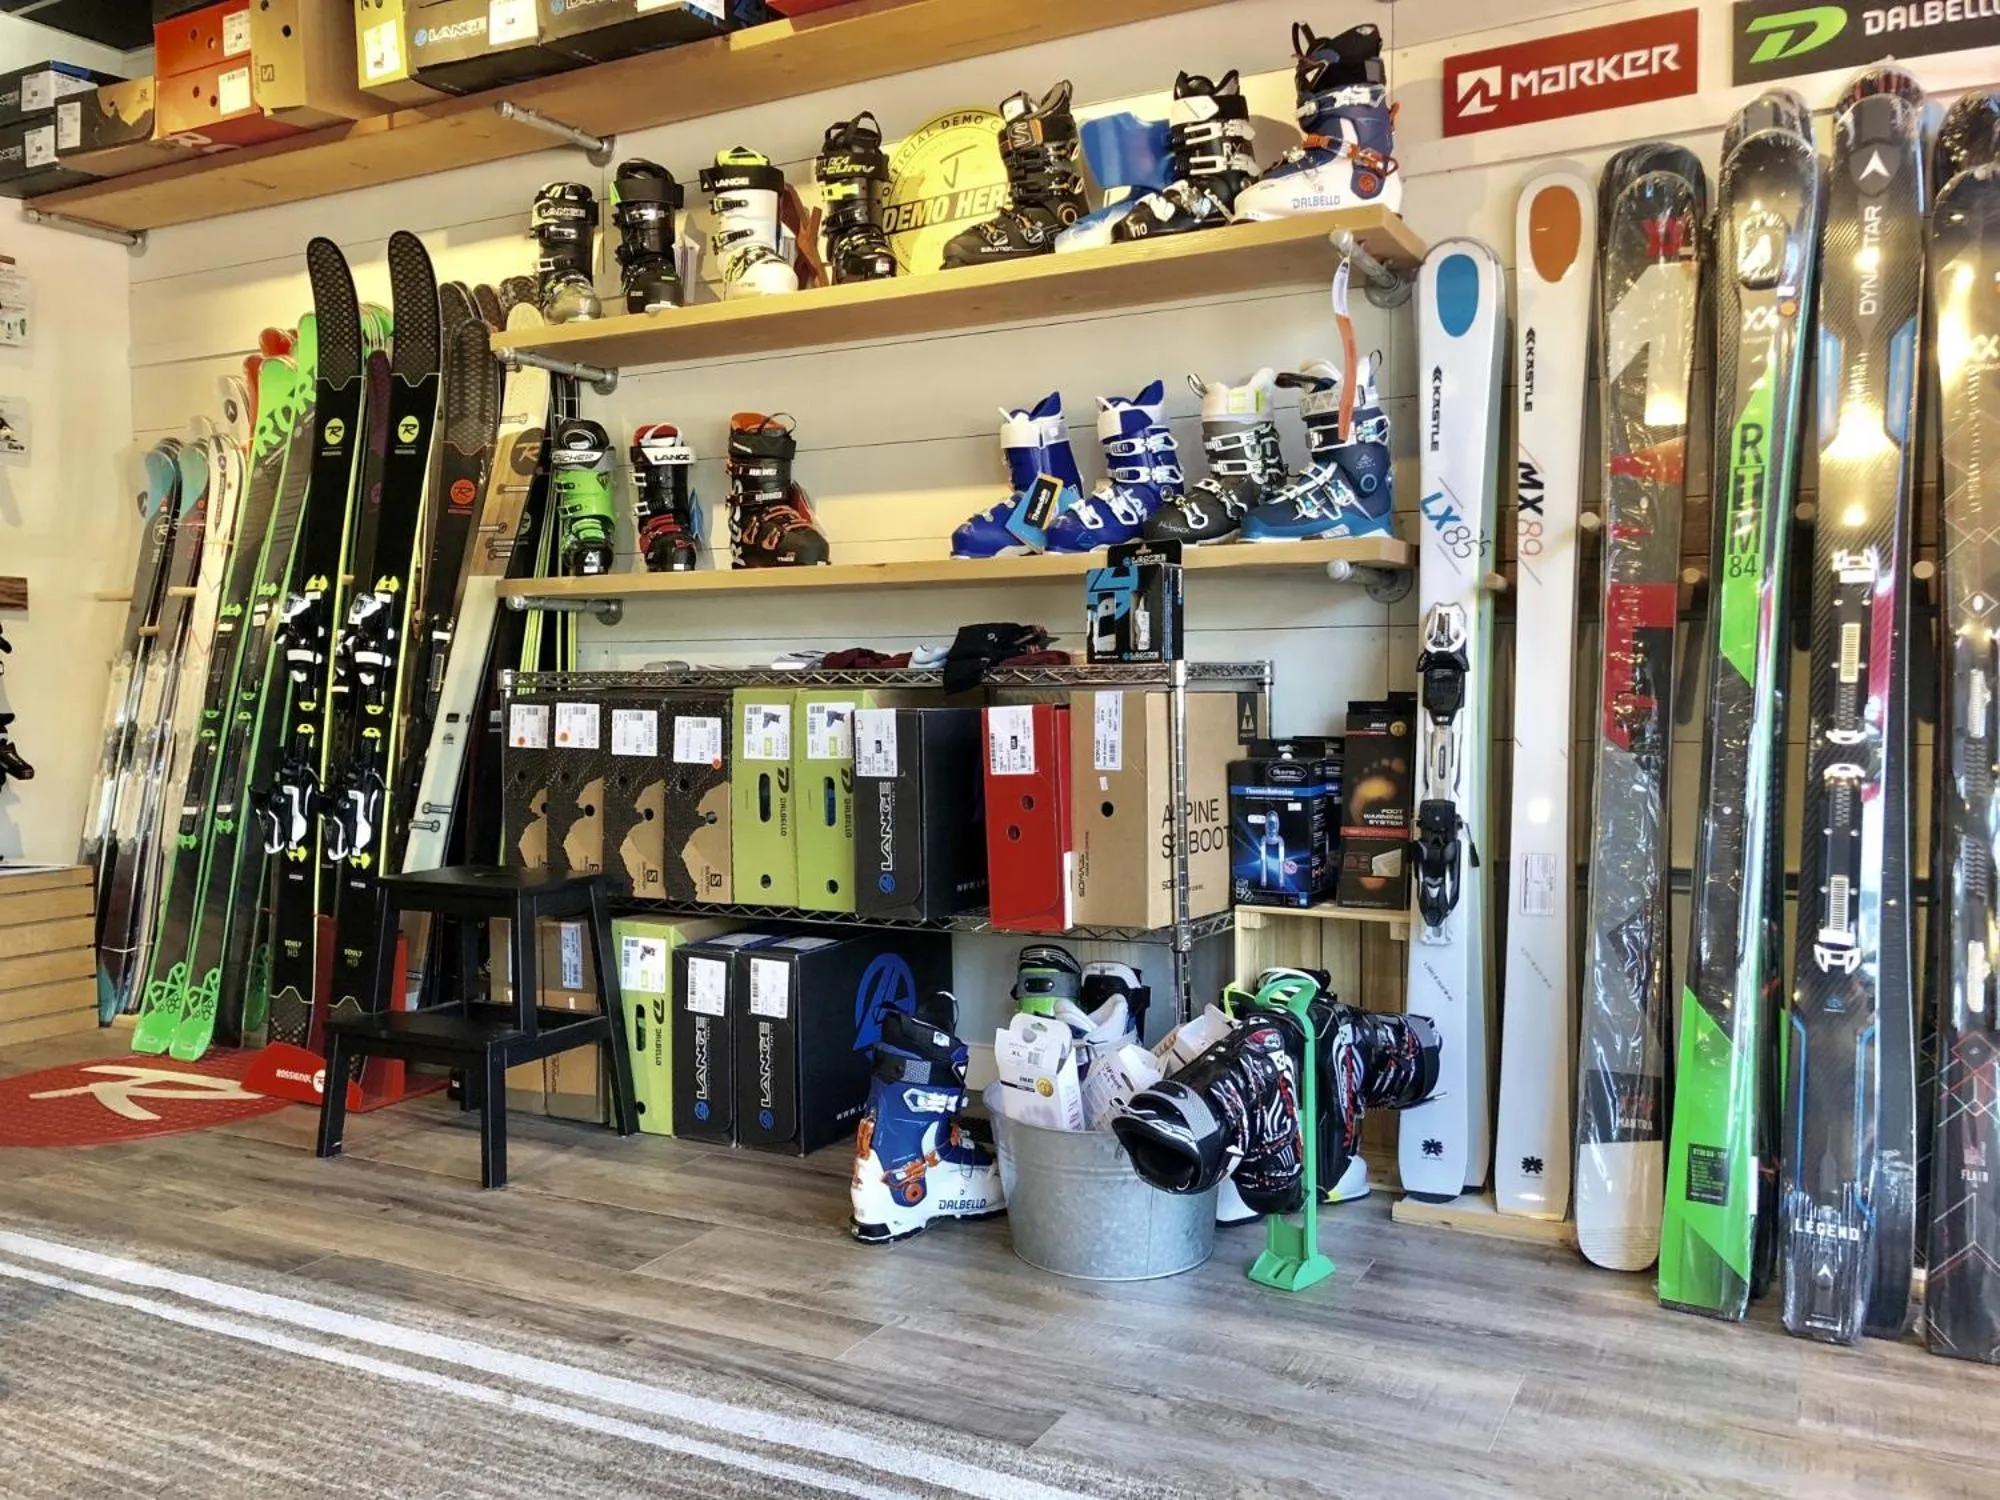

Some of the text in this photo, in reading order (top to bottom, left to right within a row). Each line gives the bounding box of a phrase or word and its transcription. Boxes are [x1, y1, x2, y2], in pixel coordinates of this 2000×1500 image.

[1862, 0, 2000, 36] DALBELL
[1511, 43, 1682, 101] MARKER
[941, 115, 984, 130] DEMO
[715, 177, 750, 187] LANGE
[882, 196, 950, 234] DEMO
[1292, 195, 1341, 209] DALBELLO
[1130, 223, 1148, 238] 110
[654, 453, 690, 461] LANGE
[1728, 554, 1757, 578] 84
[780, 797, 788, 837] DALBELLO
[844, 798, 853, 839] DALBELLO
[879, 782, 893, 871] LANGE
[1162, 798, 1219, 829] APINE
[695, 1016, 708, 1100] LANGE
[759, 1021, 772, 1107] LANGE
[938, 1198, 987, 1210] DALBELLO
[1795, 1218, 1860, 1241] LEGEND
